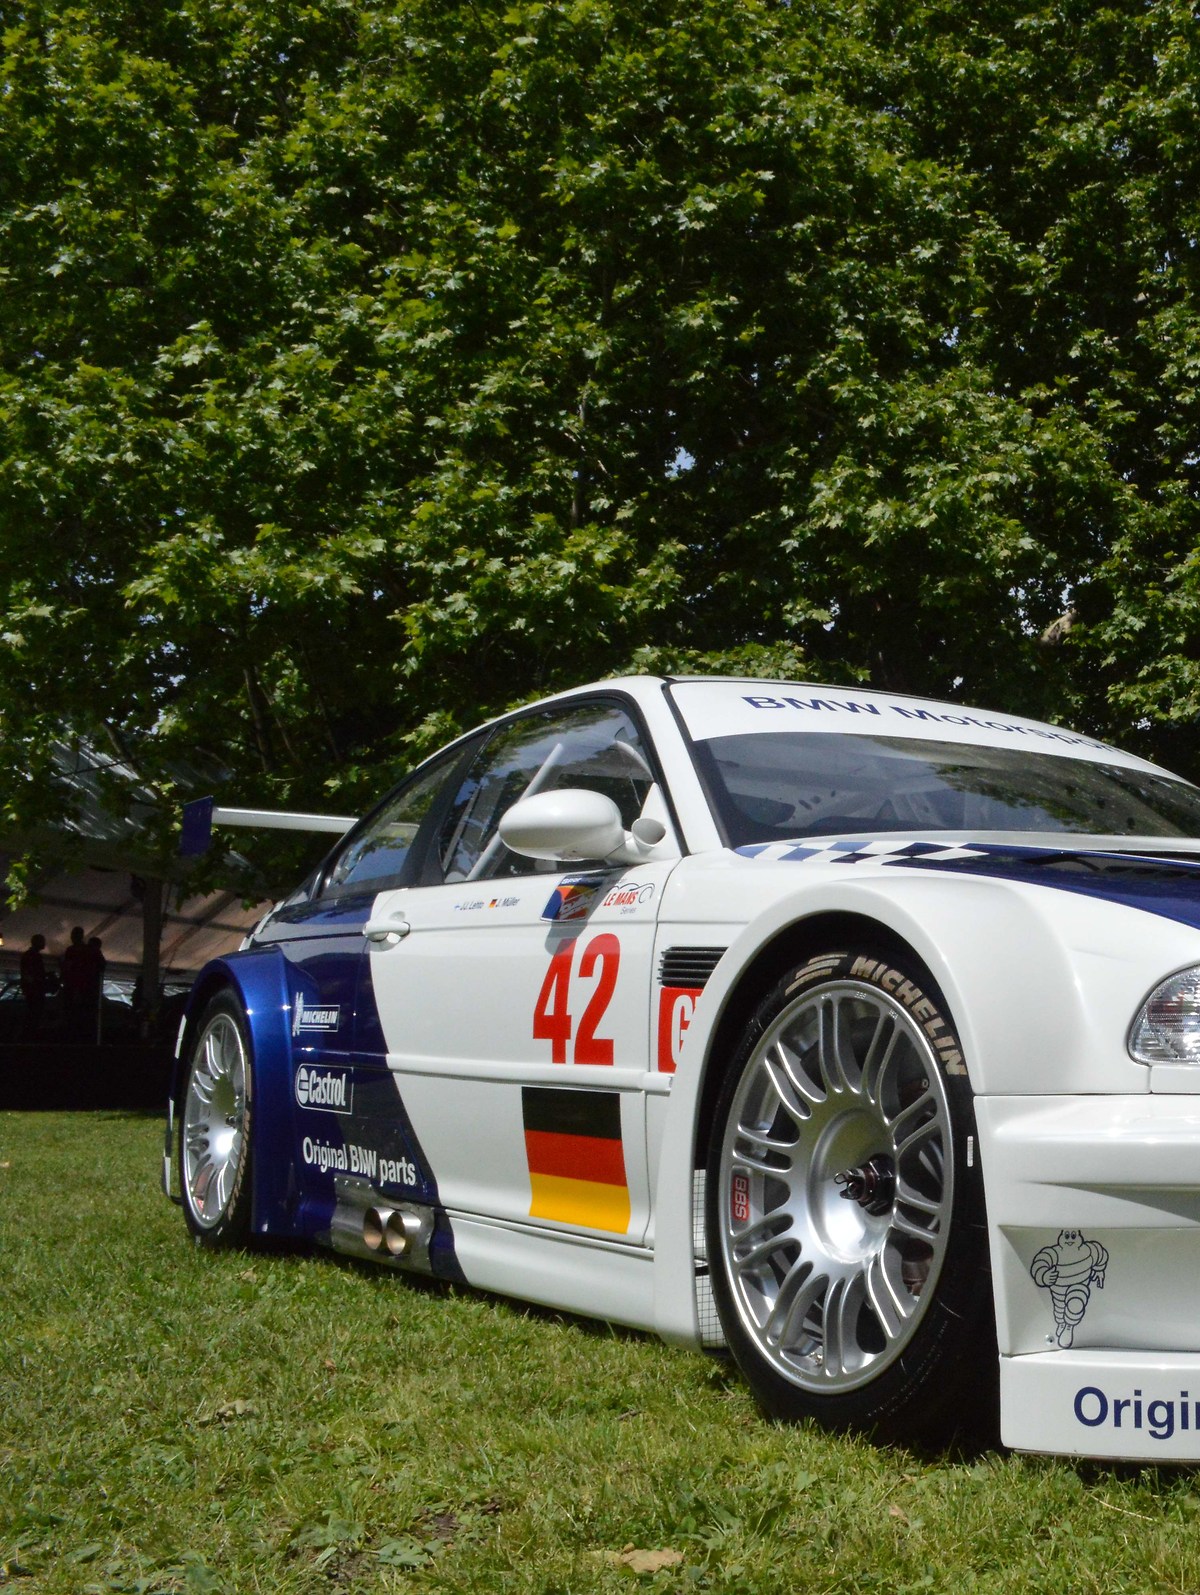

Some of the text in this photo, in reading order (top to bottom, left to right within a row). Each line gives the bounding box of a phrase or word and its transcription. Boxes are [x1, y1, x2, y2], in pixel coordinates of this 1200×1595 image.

[740, 696, 881, 715] BMW
[603, 891, 638, 906] LE MANS
[301, 1010, 338, 1024] MICHELIN
[533, 933, 620, 1066] 42
[850, 954, 968, 1076] MICHELIN
[671, 994, 700, 1065] G
[308, 1069, 346, 1106] Castrol
[303, 1136, 416, 1187] Original BMW parts
[735, 1177, 747, 1219] BBS
